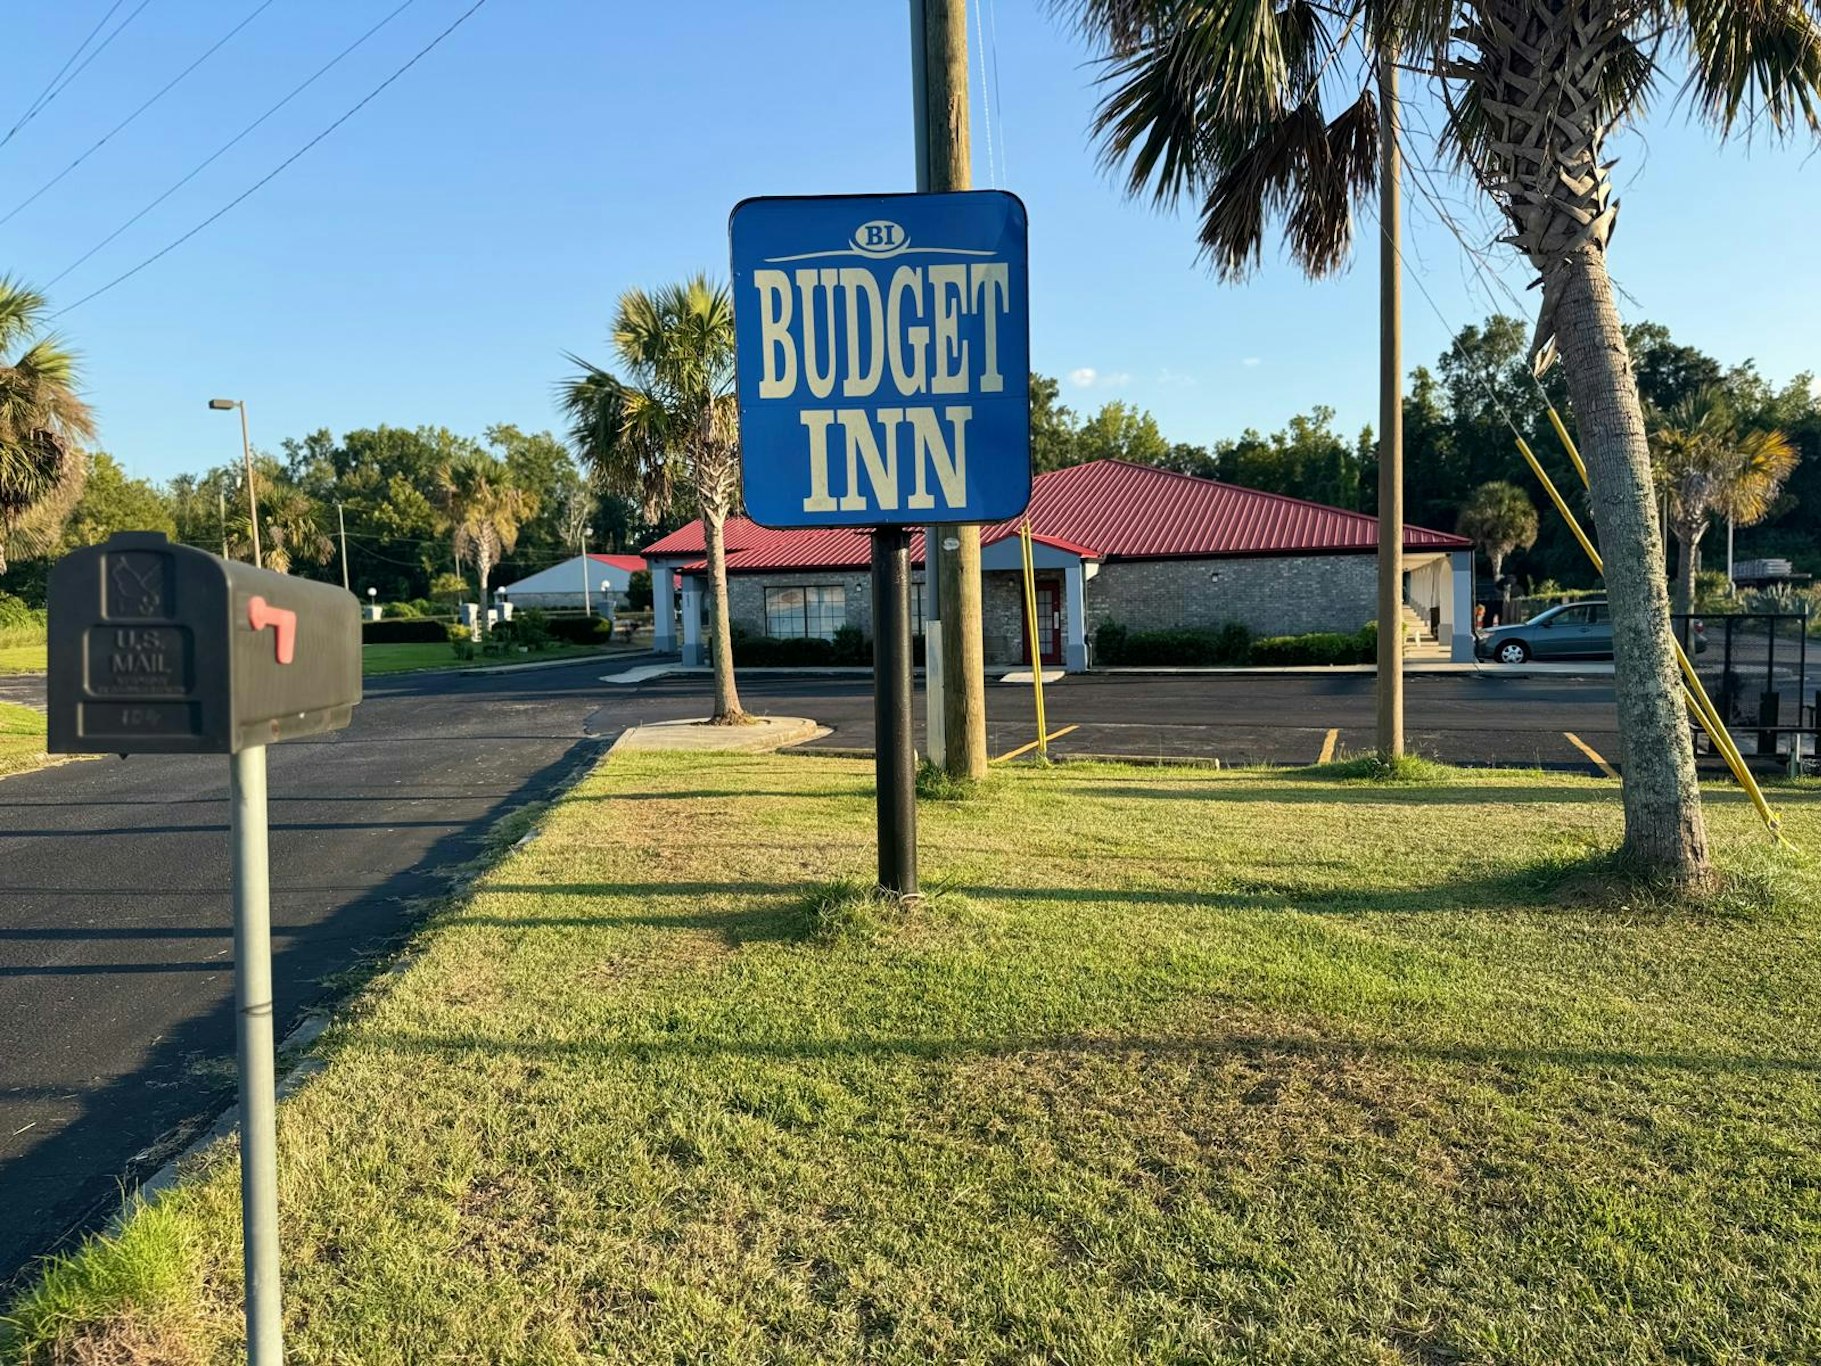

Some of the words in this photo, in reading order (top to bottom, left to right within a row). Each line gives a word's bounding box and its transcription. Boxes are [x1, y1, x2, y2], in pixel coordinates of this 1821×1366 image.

[864, 225, 895, 246] BI
[754, 262, 1009, 399] BUDGET
[800, 406, 972, 512] INN
[116, 629, 166, 651] U.S.
[112, 653, 172, 673] MAIL
